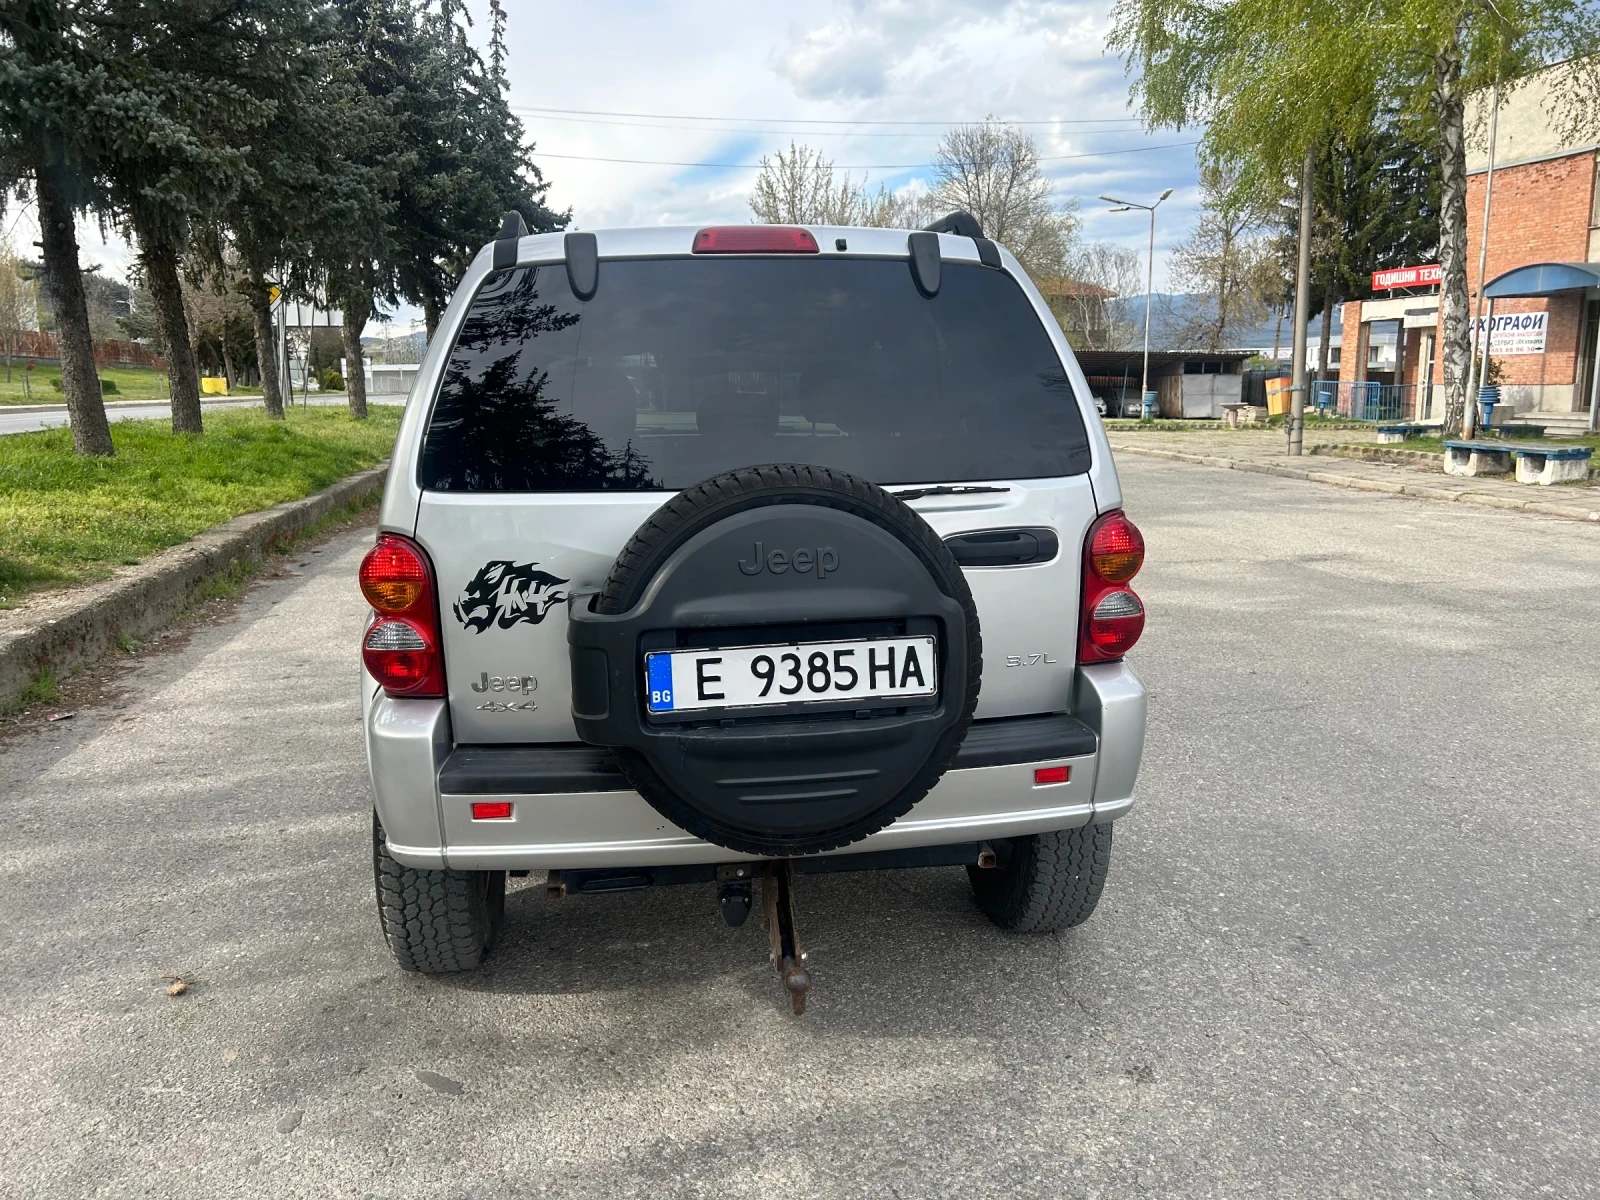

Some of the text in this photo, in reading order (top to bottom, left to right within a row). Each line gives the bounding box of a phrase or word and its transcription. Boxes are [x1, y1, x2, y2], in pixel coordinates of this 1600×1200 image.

[1375, 270, 1416, 286] ГОДИШНИ
[738, 541, 840, 580] Jeep
[1006, 652, 1057, 668] 3.7L
[471, 672, 538, 696] Jeep
[652, 645, 925, 703] BG E 9385 HA
